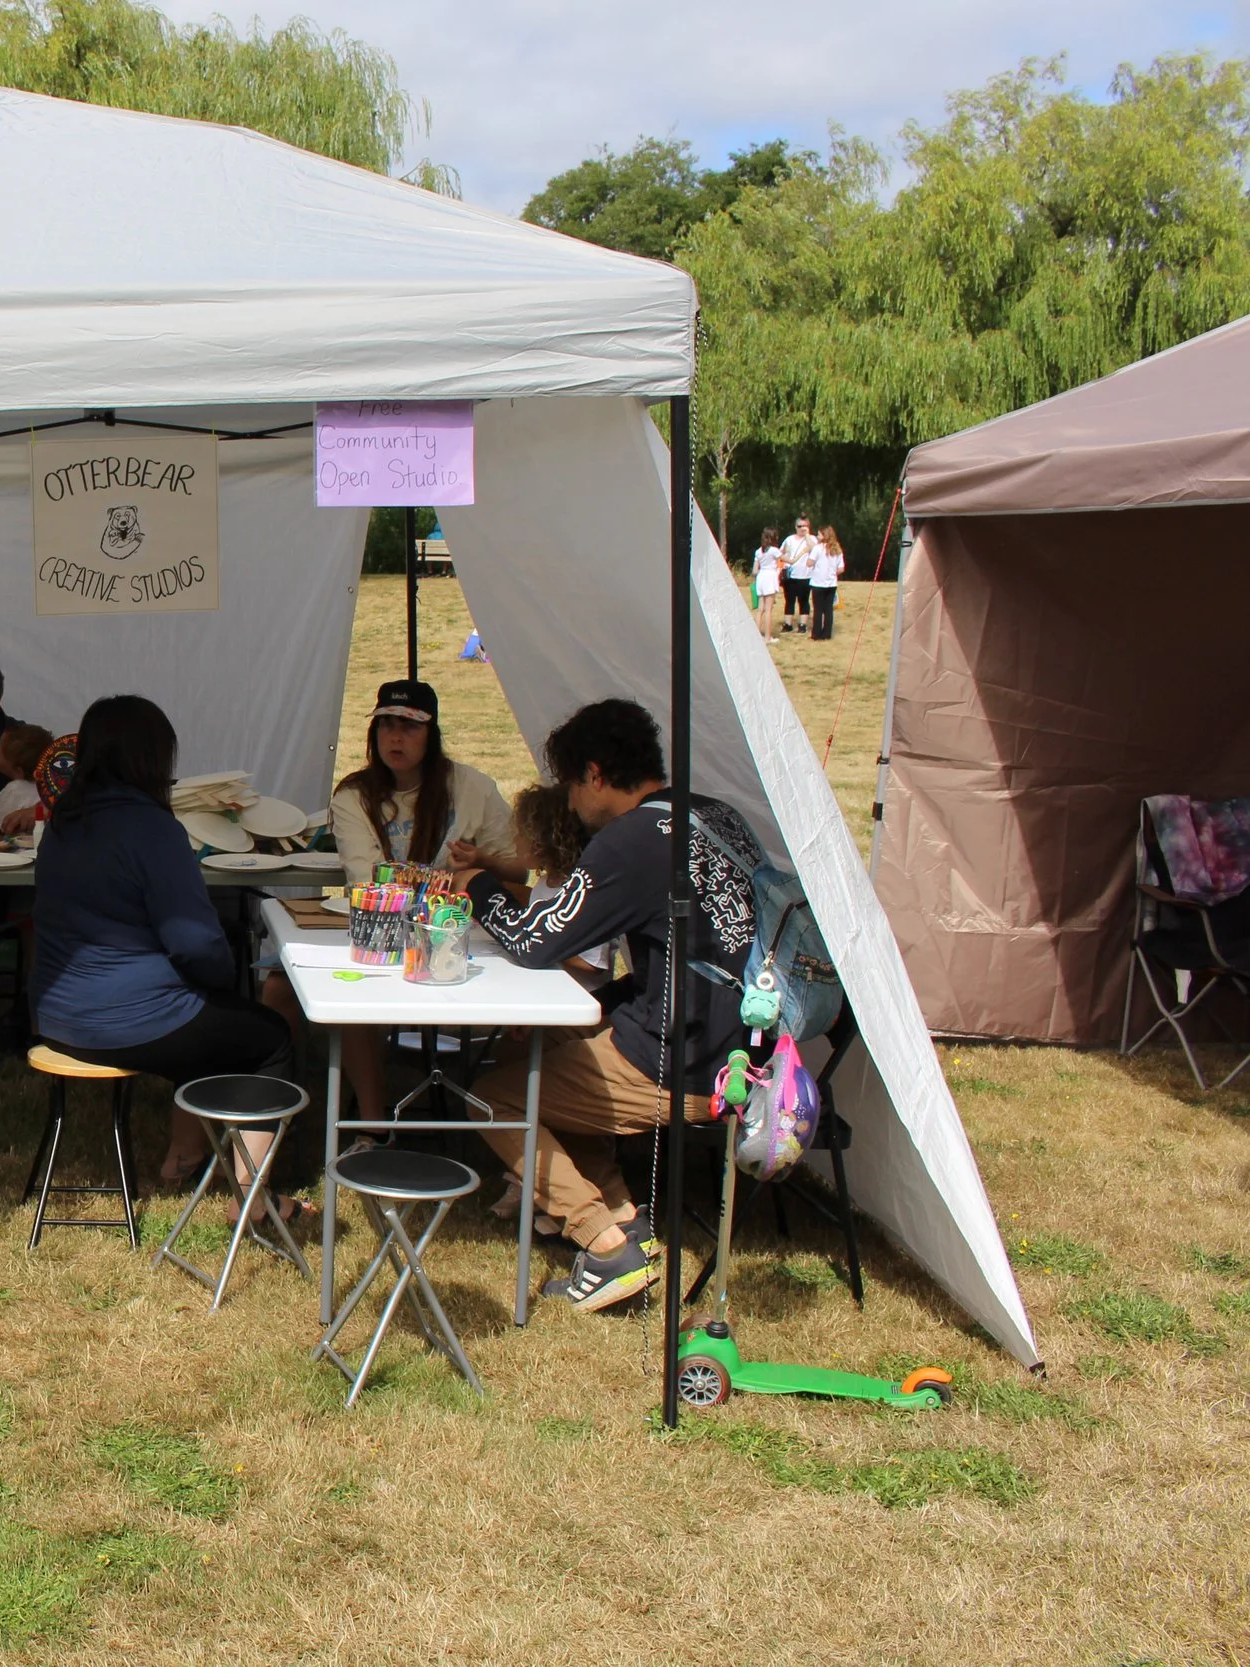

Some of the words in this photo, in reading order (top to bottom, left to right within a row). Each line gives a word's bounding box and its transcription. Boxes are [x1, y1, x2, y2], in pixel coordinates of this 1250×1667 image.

[358, 400, 403, 417] Free
[318, 424, 437, 460] Community
[44, 456, 195, 501] OTTERBEAR
[320, 460, 370, 495] Open
[387, 458, 458, 489] Studio
[39, 556, 125, 602] CREATIVE
[131, 556, 205, 602] STUDIOS
